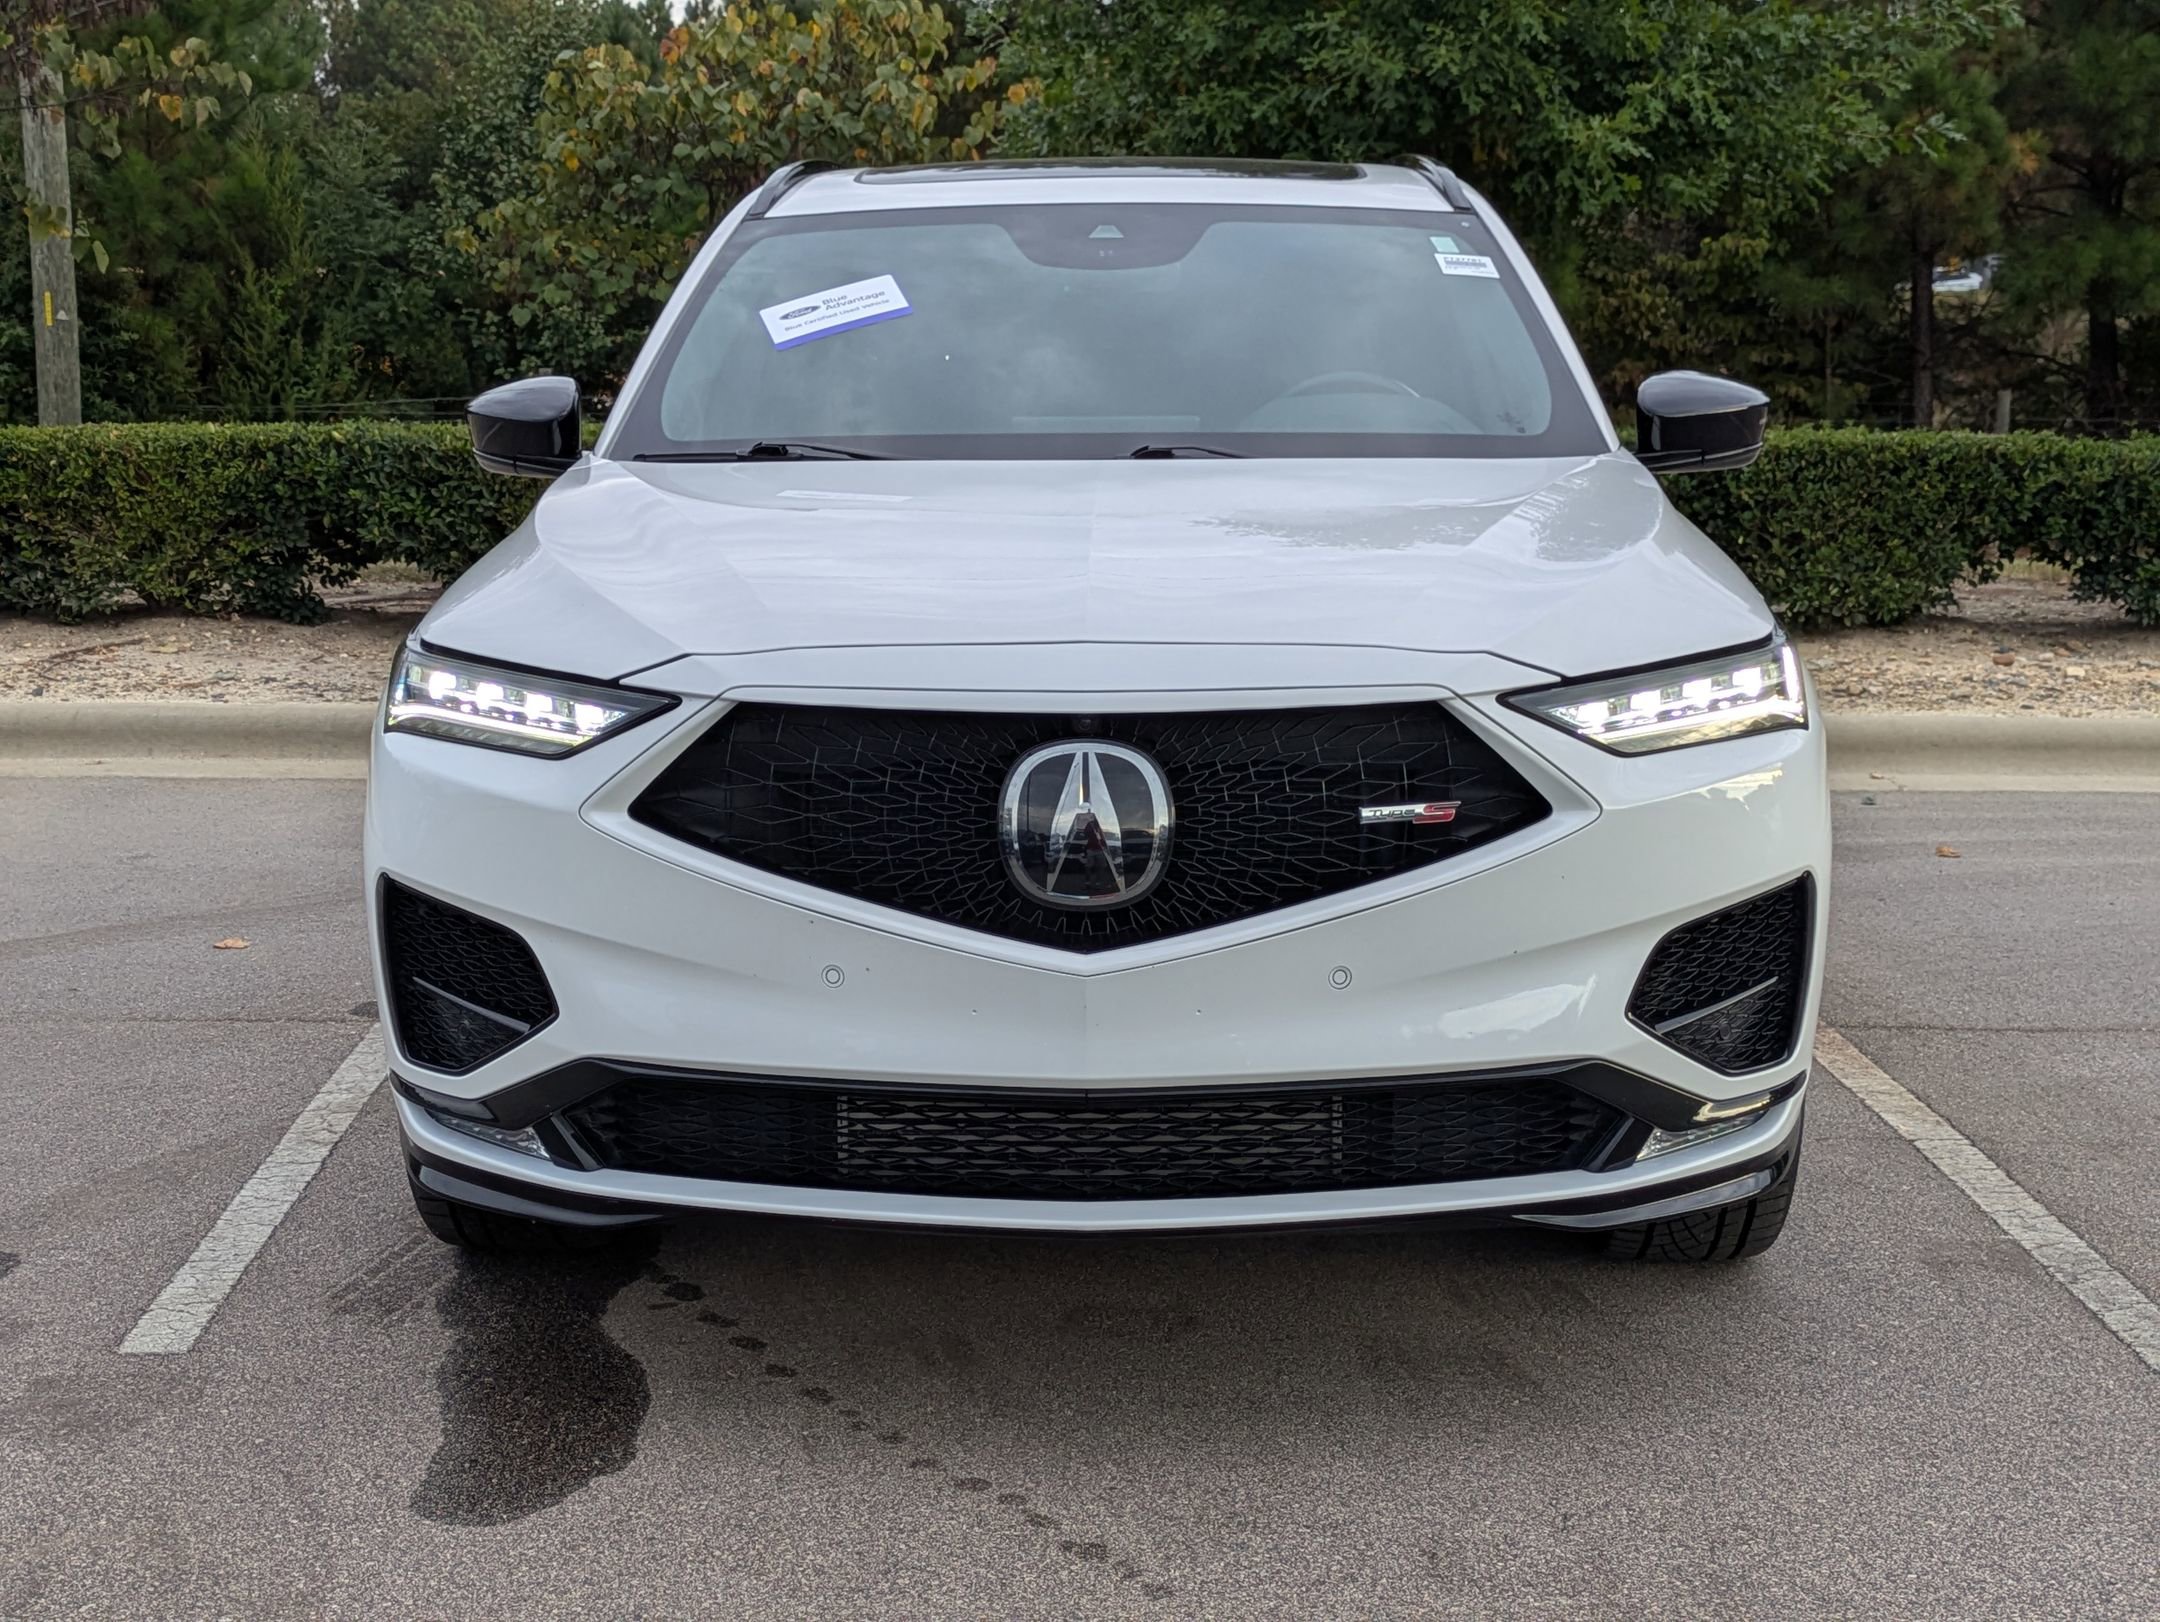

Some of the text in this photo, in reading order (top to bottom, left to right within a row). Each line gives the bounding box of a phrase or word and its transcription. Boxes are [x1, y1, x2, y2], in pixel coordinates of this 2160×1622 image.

[822, 295, 847, 305] Blue
[825, 291, 886, 311] Advantage
[785, 306, 815, 320] Ford
[785, 323, 803, 331] Blue
[805, 312, 838, 325] Certified
[839, 306, 860, 315] Used
[1412, 801, 1462, 824] S
